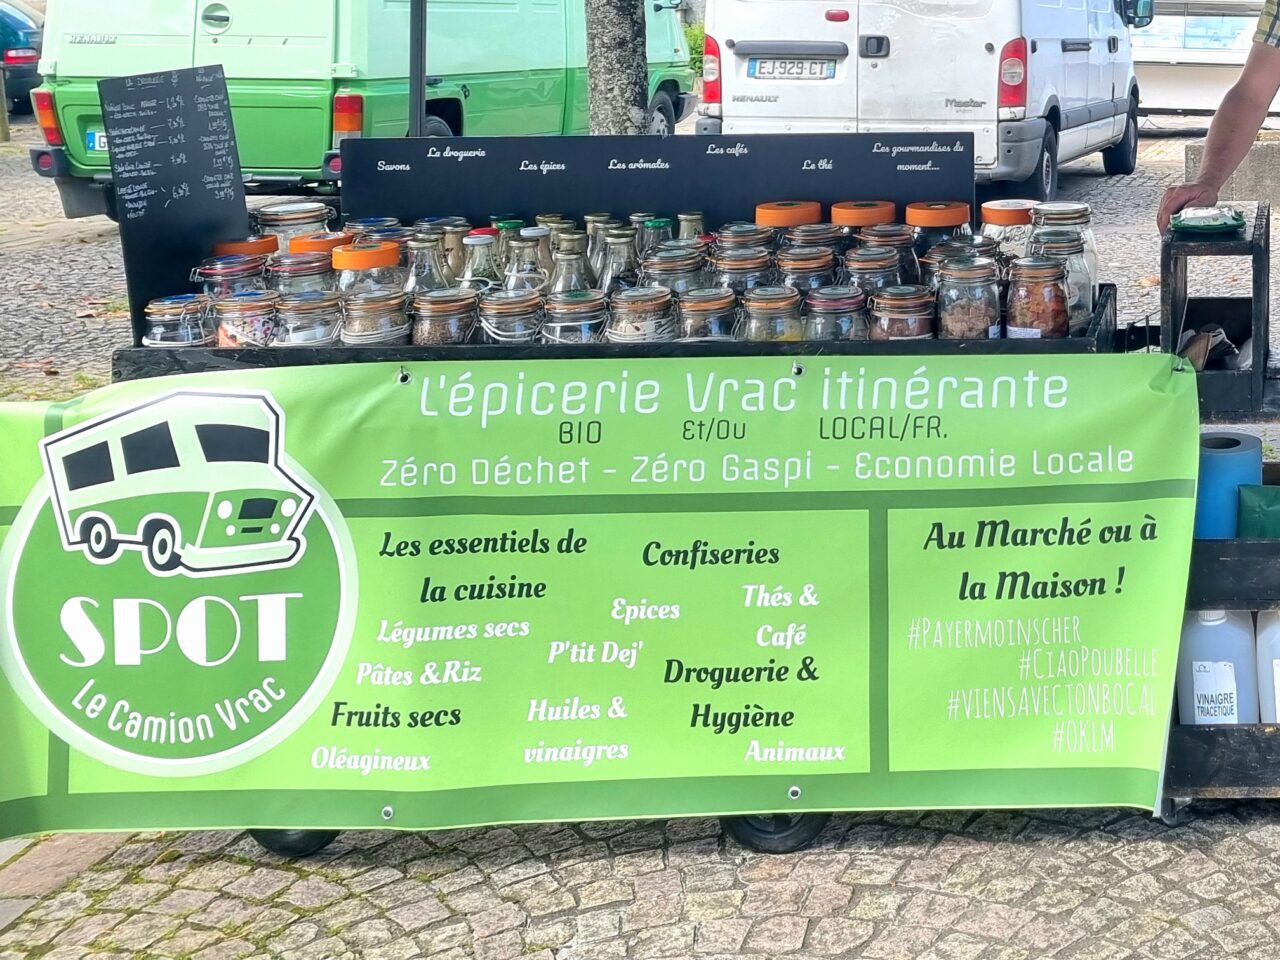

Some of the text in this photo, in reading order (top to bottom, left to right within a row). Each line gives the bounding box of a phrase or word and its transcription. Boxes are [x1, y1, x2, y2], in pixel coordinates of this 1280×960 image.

[758, 60, 826, 76] EJ-929-CT
[427, 147, 486, 162] La droguerie
[706, 143, 749, 157] Les cafés
[872, 141, 964, 157] Les gourmandises du
[377, 160, 411, 172] Savons
[519, 160, 566, 175] Les épices
[608, 158, 670, 169] Les arômates
[801, 159, 833, 170] Le thé
[419, 368, 1068, 428] L'épicerie Vrac itinérante
[559, 421, 601, 445] BIO
[820, 415, 948, 440] LOCAL/FR.
[381, 445, 1133, 488] Zéro Déchet Zéro Gaspi Economie Locale
[380, 528, 587, 557] Les essentiels de
[924, 514, 1157, 550] Au Marché ou à
[642, 541, 779, 570] Confiseries
[421, 577, 546, 603] la cuisine
[743, 584, 819, 607] Thés &
[959, 567, 1125, 602] la Maison !
[611, 599, 680, 625] Epices
[59, 592, 303, 667] SPOT
[377, 620, 529, 646] Légumes secs
[756, 624, 806, 650] Café
[548, 641, 643, 668] P'tit Dej'
[356, 662, 413, 687] Pâtes
[664, 656, 819, 686] Droguerie &
[72, 676, 286, 743] Le Camion Vrac
[527, 698, 627, 723] Huiles &
[1197, 692, 1235, 705] VINAIGRE
[1197, 705, 1235, 717] TRIACETIQUE
[331, 702, 461, 728] Fruits secs
[690, 703, 794, 734] Hygiène
[1052, 720, 1115, 753] #OKLM
[311, 746, 431, 773] Oléagineux
[523, 742, 629, 770] vinaigres
[744, 741, 845, 763] Animaux
